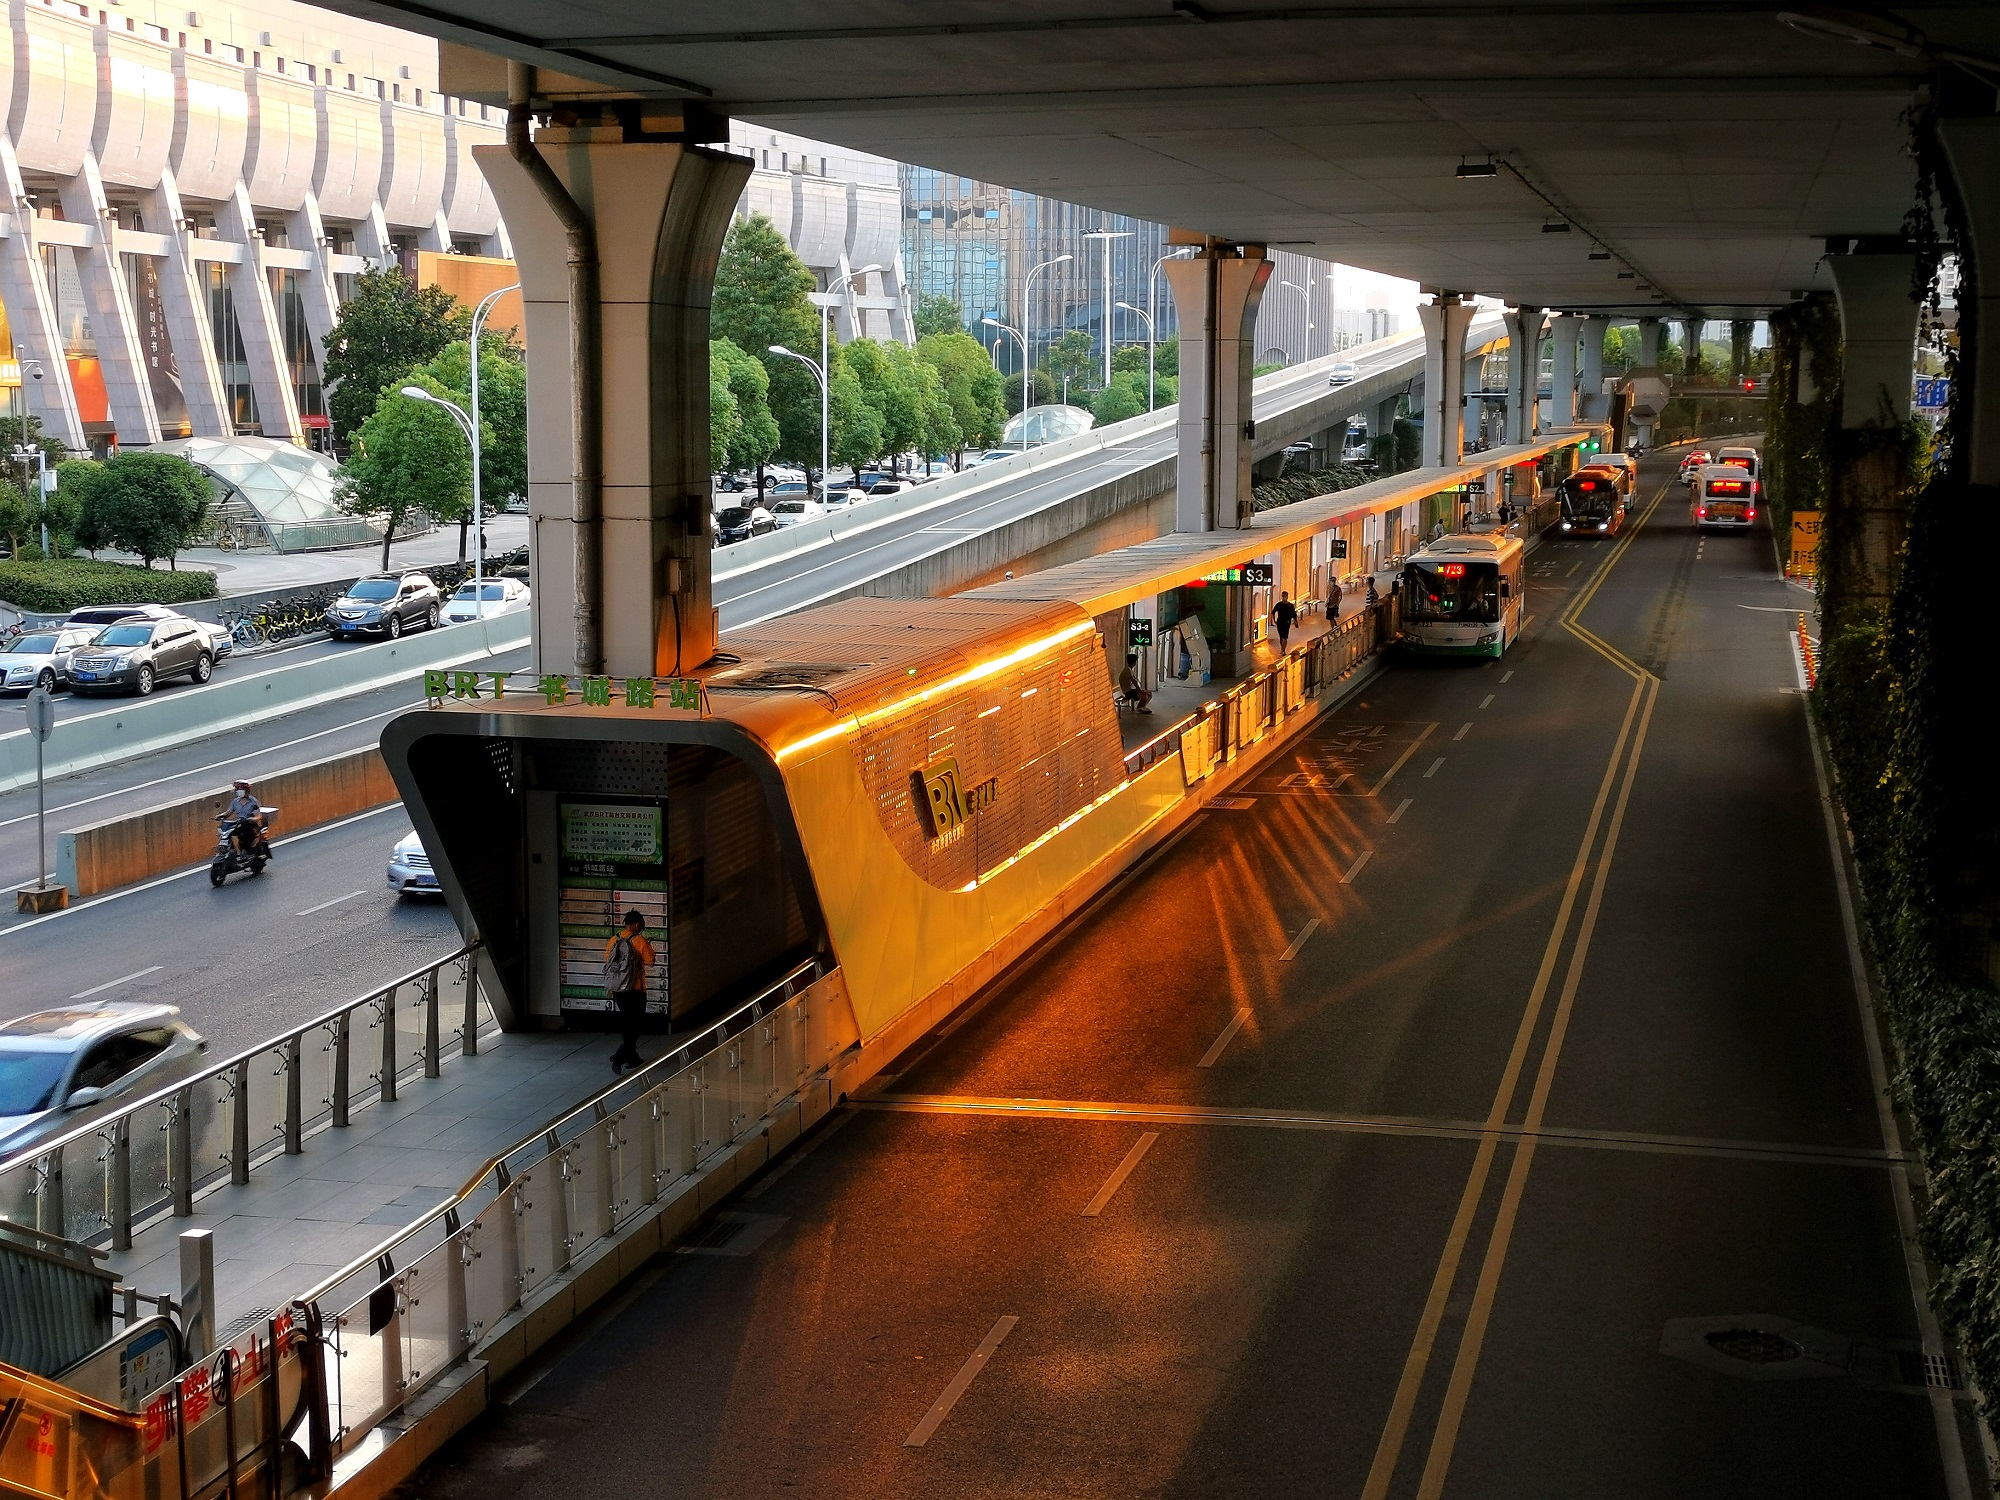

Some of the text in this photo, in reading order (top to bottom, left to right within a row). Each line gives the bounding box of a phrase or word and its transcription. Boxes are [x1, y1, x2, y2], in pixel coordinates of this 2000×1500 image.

[1245, 568, 1264, 583] S3
[1130, 622, 1149, 631] S3-2
[424, 669, 703, 711] BRT 书城路站
